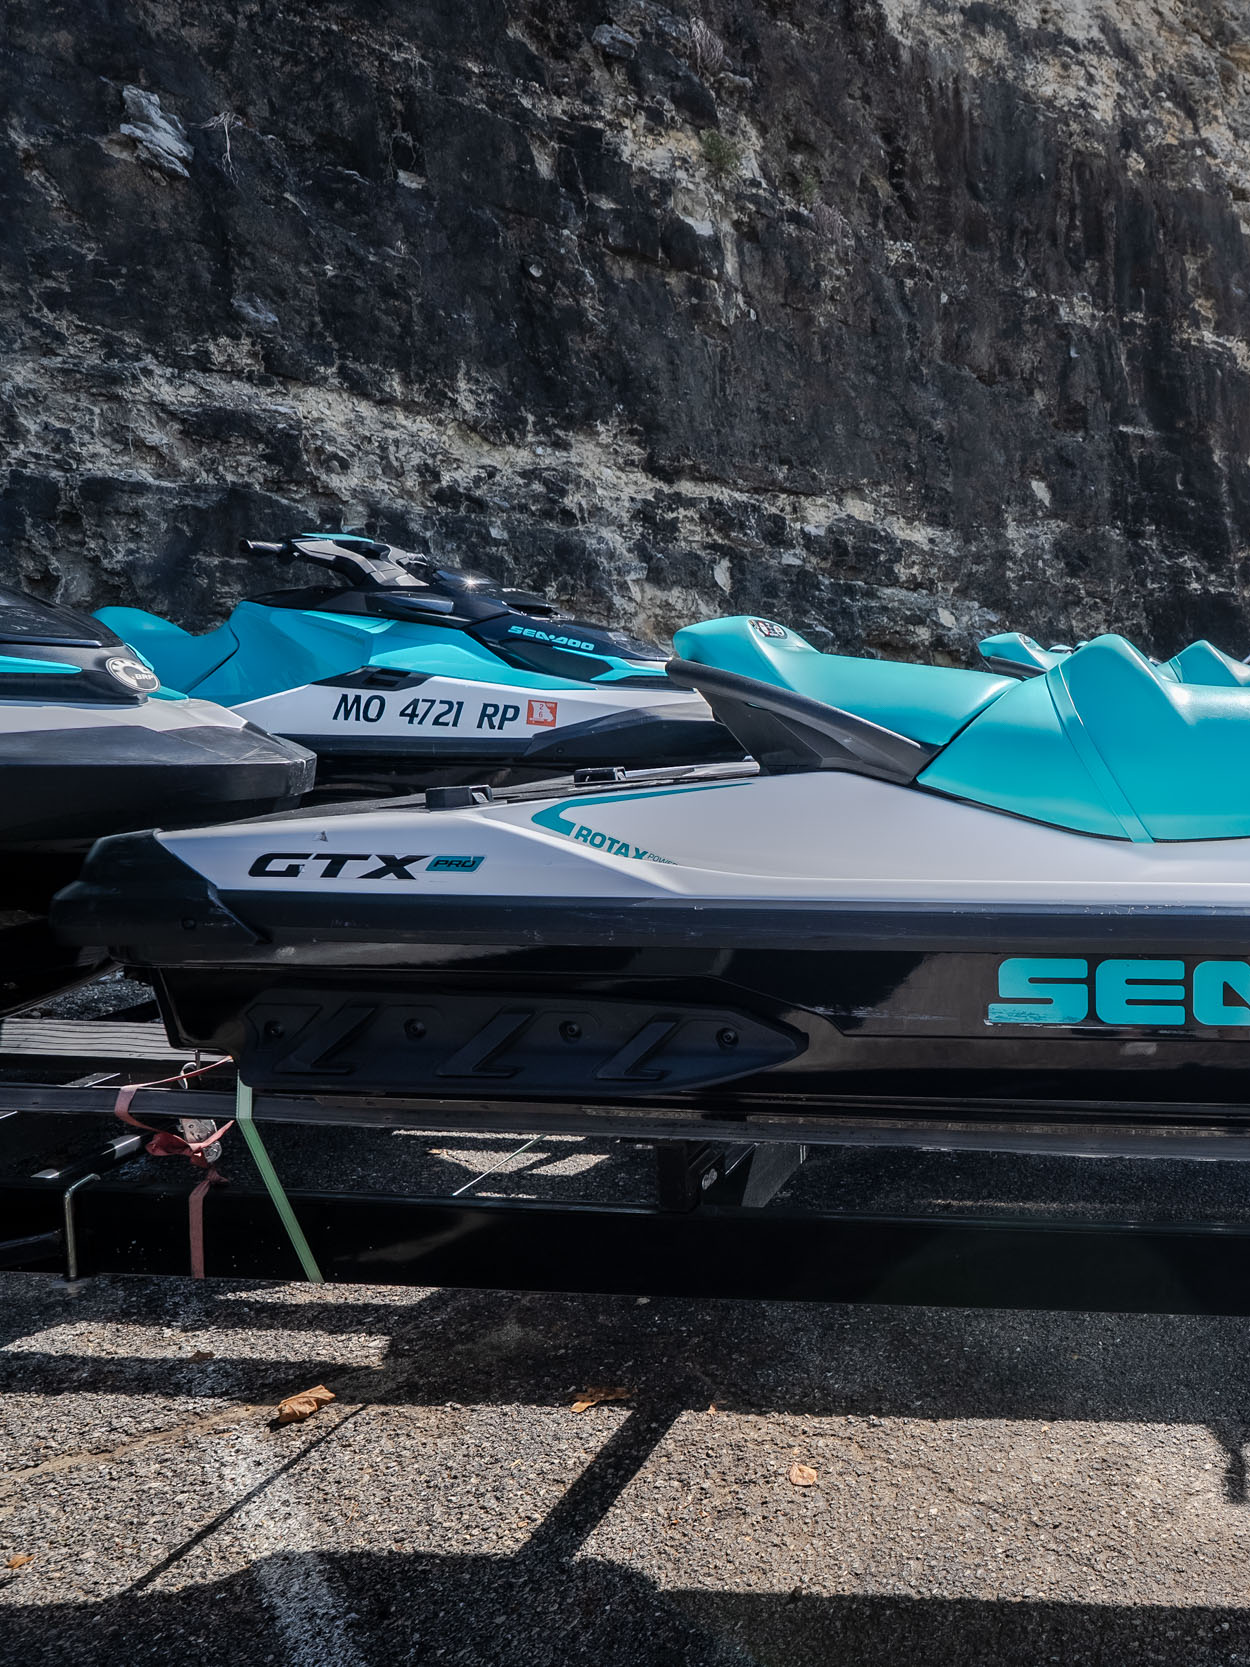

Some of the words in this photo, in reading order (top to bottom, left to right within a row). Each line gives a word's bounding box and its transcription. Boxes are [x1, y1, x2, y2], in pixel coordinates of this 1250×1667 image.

[332, 693, 386, 723] MO
[399, 698, 465, 727] 4721
[476, 703, 521, 731] RP
[574, 825, 649, 860] ROTAX
[248, 852, 432, 880] GTX
[432, 859, 477, 868] PRO
